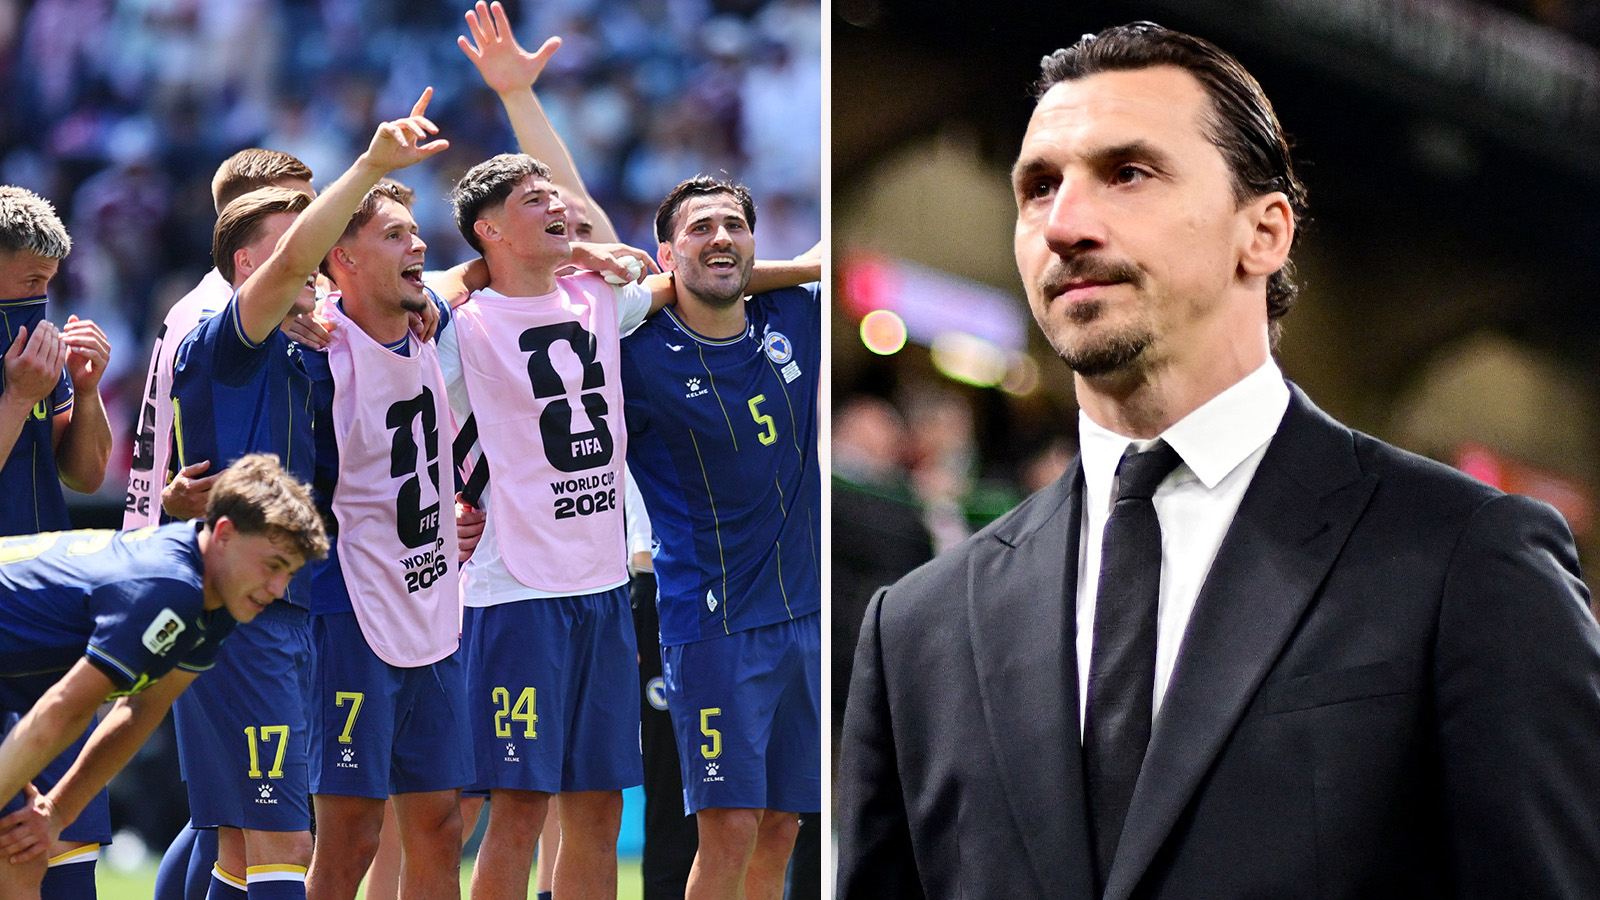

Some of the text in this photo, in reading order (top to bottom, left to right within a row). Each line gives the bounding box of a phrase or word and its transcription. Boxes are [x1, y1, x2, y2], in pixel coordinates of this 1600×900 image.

[686, 389, 709, 399] KELME
[748, 394, 778, 447] 5
[571, 437, 603, 458] FIFA
[550, 475, 600, 495] WORLD
[554, 488, 616, 520] 2026
[419, 511, 438, 534] FIF
[335, 691, 364, 744] 7
[492, 686, 538, 740] 24
[700, 707, 722, 760] 5
[244, 725, 290, 779] 17
